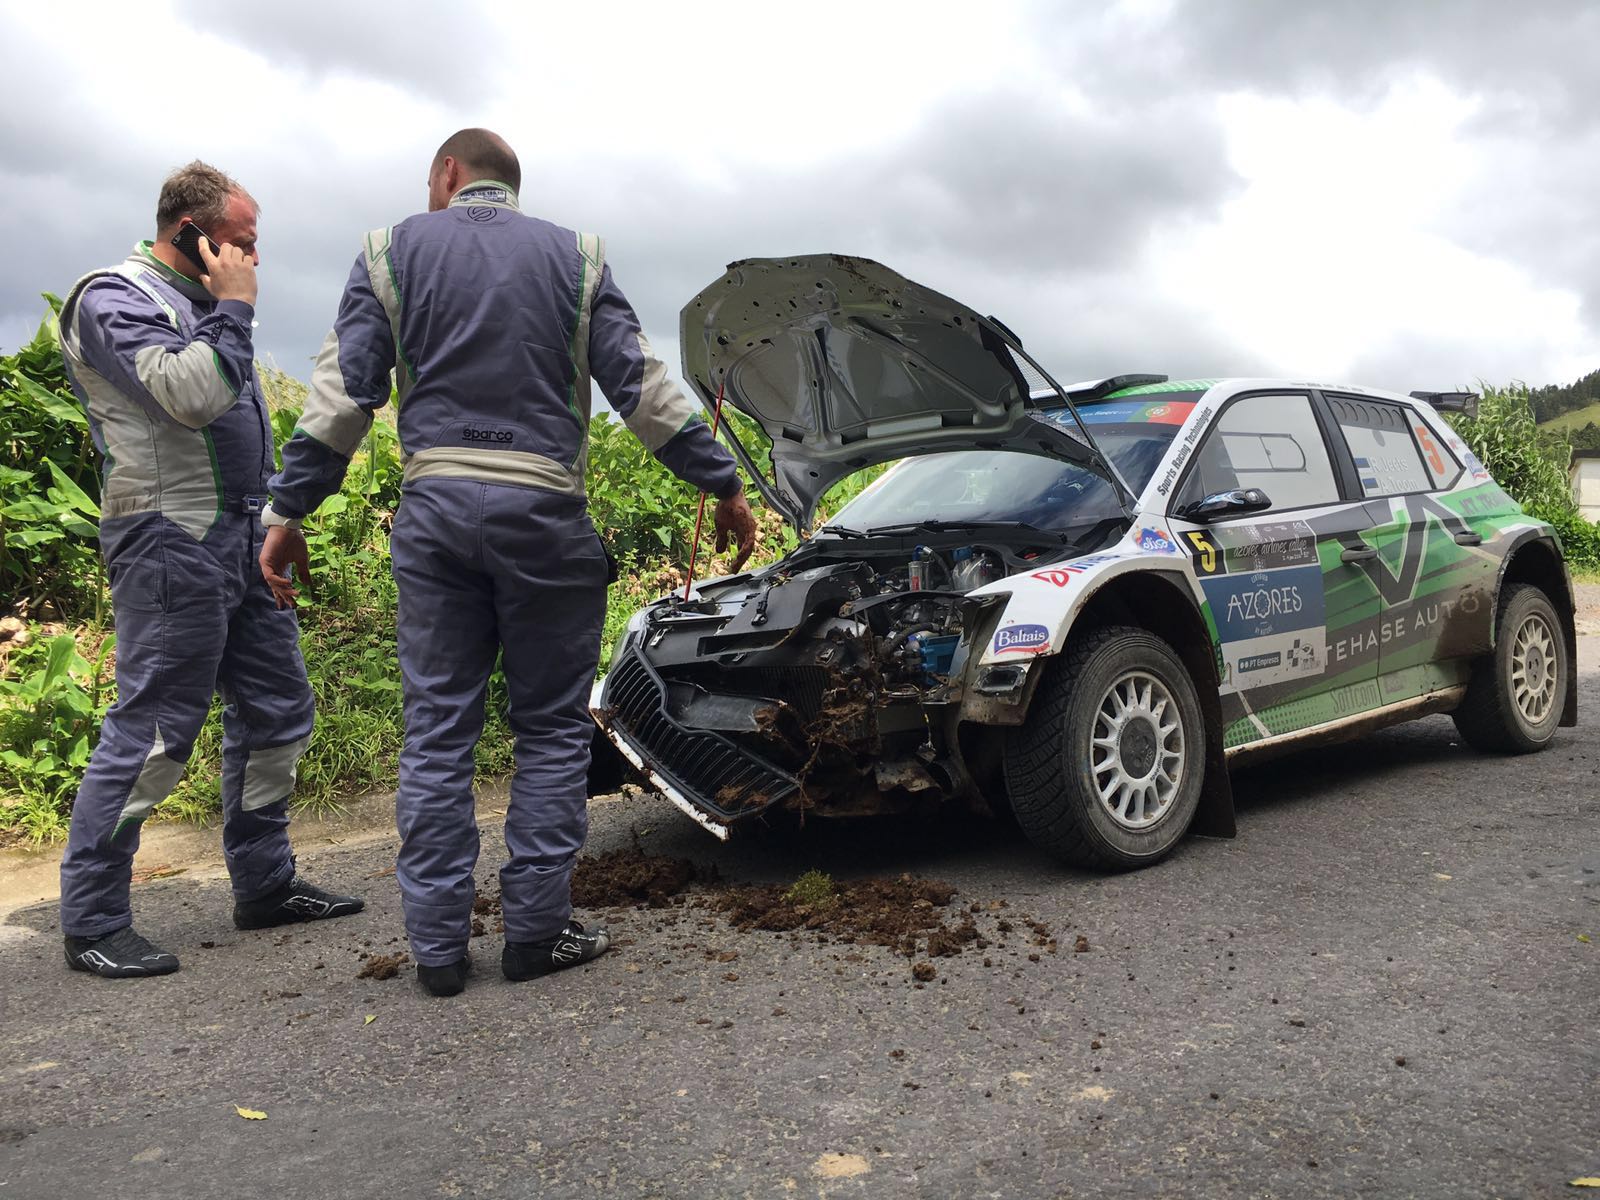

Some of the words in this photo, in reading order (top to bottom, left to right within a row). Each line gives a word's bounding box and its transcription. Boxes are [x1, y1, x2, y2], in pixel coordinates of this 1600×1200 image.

[462, 428, 514, 443] sparco
[1157, 468, 1177, 496] Sports
[1171, 444, 1191, 470] Racing
[1184, 407, 1213, 446] Technologies
[1414, 426, 1446, 476] 5
[1188, 532, 1216, 573] 5
[1227, 586, 1303, 622] AZORES
[1414, 593, 1480, 631] AUTO
[998, 629, 1047, 647] Baltais
[1248, 658, 1257, 667] PT
[1257, 655, 1280, 665] Empresas
[1331, 685, 1378, 713] Softcom
